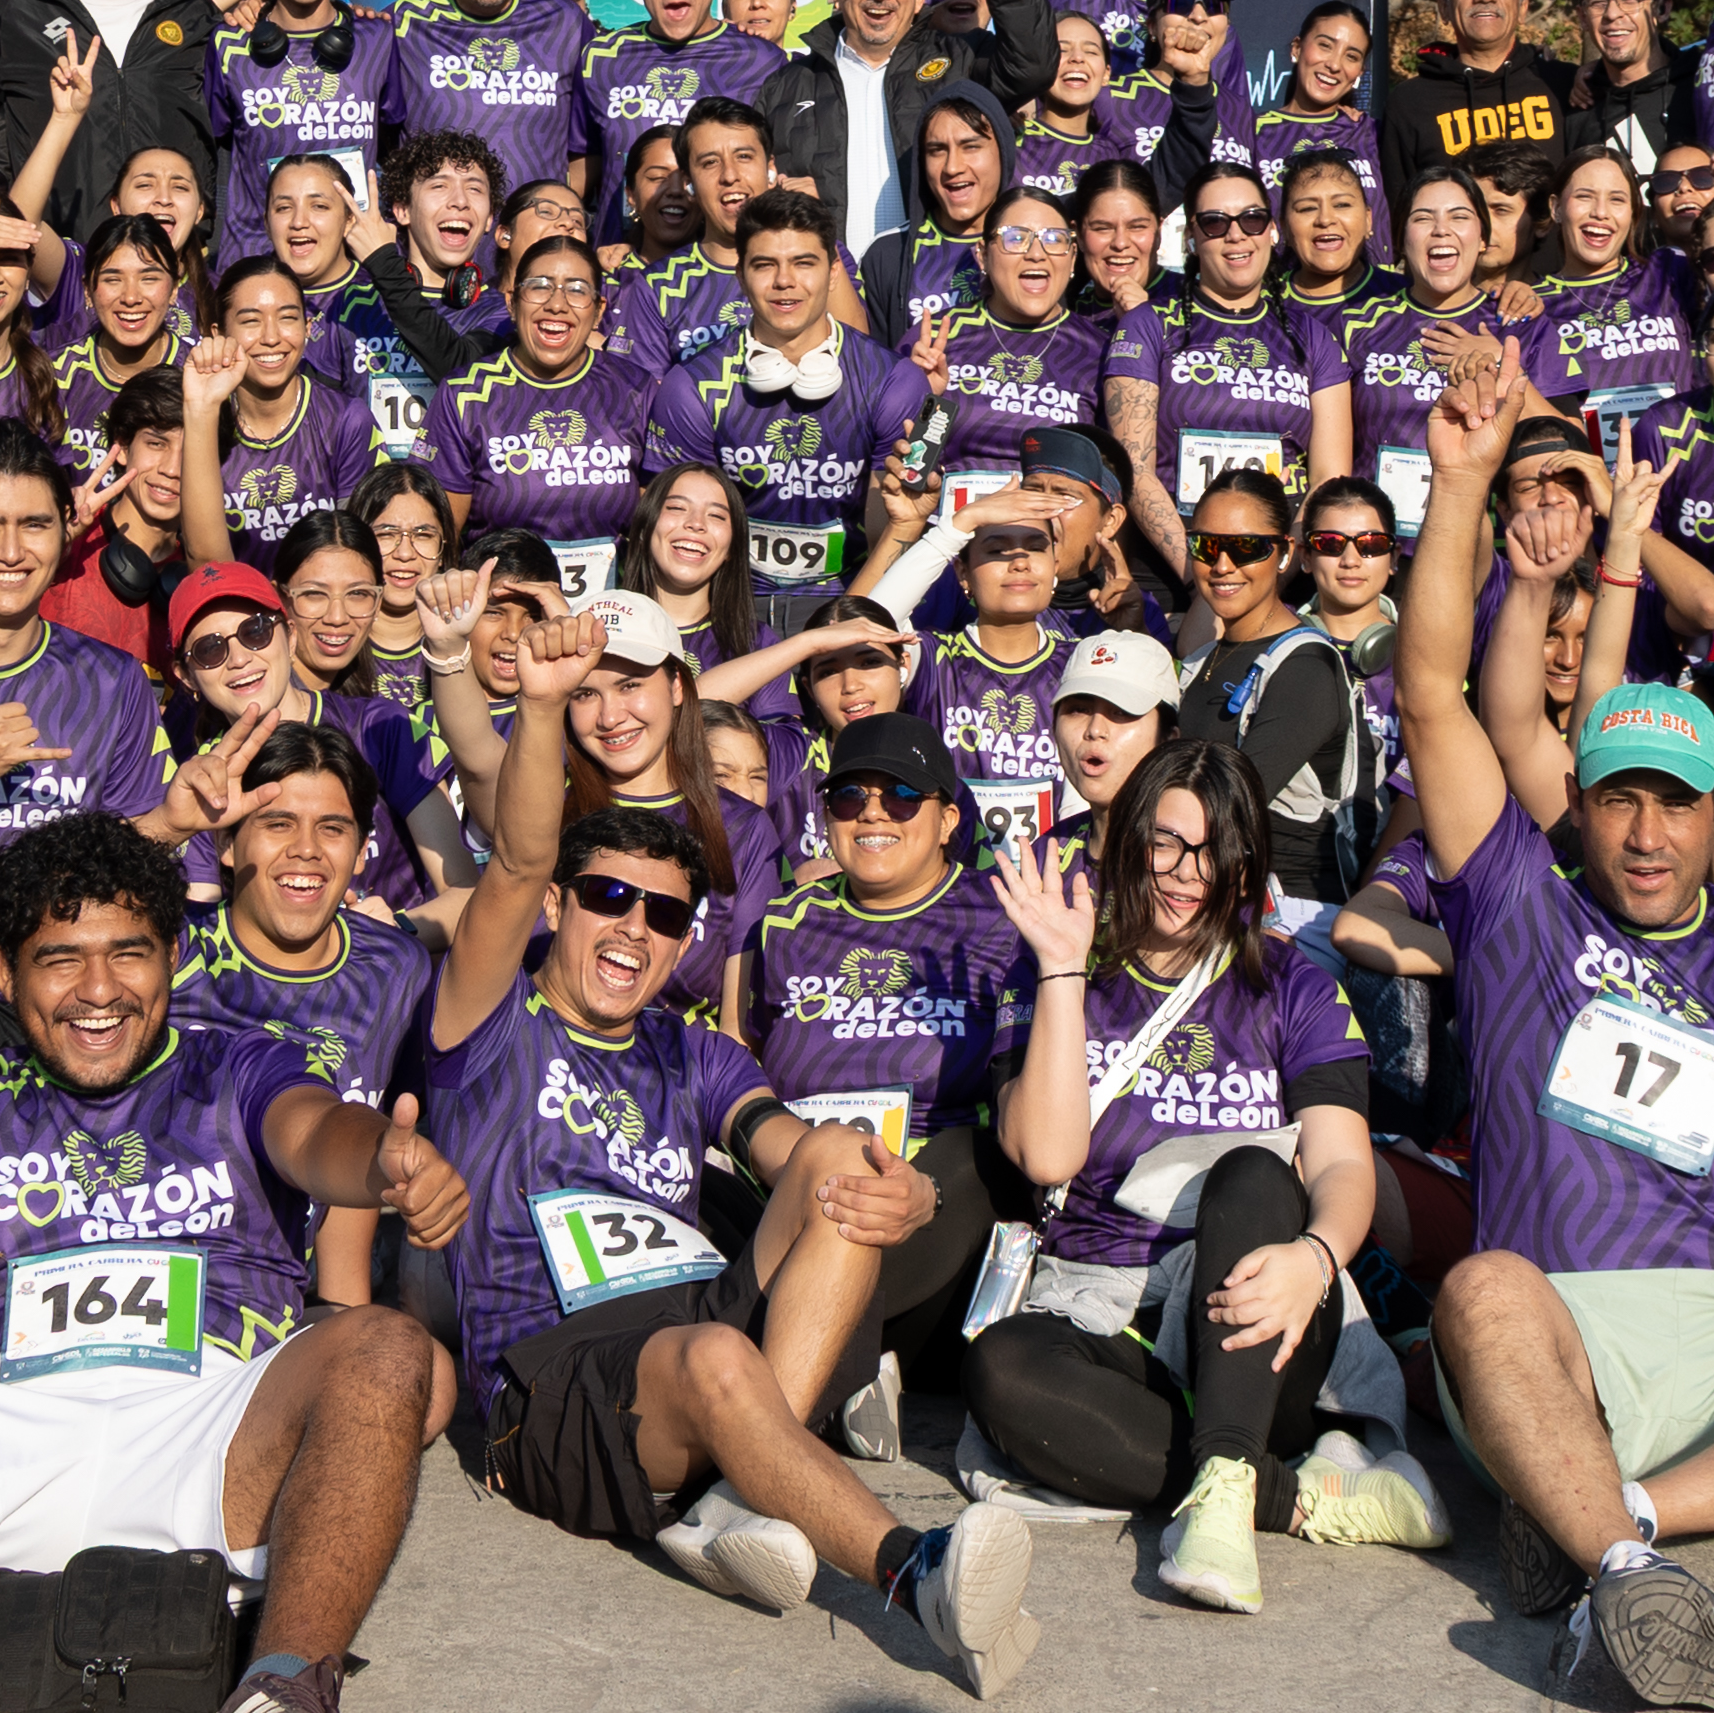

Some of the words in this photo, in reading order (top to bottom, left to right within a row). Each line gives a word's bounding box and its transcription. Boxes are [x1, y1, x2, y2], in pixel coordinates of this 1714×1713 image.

[430, 54, 477, 74] SOY
[430, 64, 558, 94] CORAZÓN
[608, 84, 654, 103] SOY
[242, 87, 288, 109] SOY
[482, 83, 557, 107] deLeón
[243, 92, 375, 130] CORAZÓN
[1436, 94, 1555, 156] UDEG
[297, 117, 375, 141] deLeón
[354, 337, 401, 357] SOY
[1172, 350, 1221, 370] SOY
[1365, 350, 1412, 371] SOY
[1601, 335, 1681, 362] deLeón
[946, 362, 992, 384] SOY
[1171, 358, 1310, 392] CORAZÓN
[990, 394, 1080, 424] deLeón
[1230, 382, 1310, 411] deLeón
[487, 440, 631, 477] CORAZÓN
[488, 435, 537, 457] SOY
[720, 446, 770, 467] SOY
[545, 460, 630, 488] deLeón
[721, 451, 865, 490] CORAZÓN
[777, 471, 858, 500] deLeón
[751, 533, 827, 570] 109
[946, 705, 989, 731] SOY
[1601, 709, 1654, 733] COSTA
[1661, 711, 1700, 747] RICA
[1578, 934, 1656, 988] SOY
[785, 974, 849, 999] SOY
[781, 986, 967, 1023] CORAZÓN
[1594, 1006, 1638, 1030] PRIMERA
[833, 1016, 967, 1051] deLeón
[1613, 1041, 1682, 1108] 17
[1151, 1100, 1281, 1129] deLeón
[557, 1199, 601, 1213] PRIMERA
[77, 1200, 235, 1244] deLeón
[591, 1212, 681, 1257] 32
[34, 1262, 84, 1278] PRIMERA
[88, 1257, 143, 1268] CARRERA
[41, 1275, 169, 1334] 164
